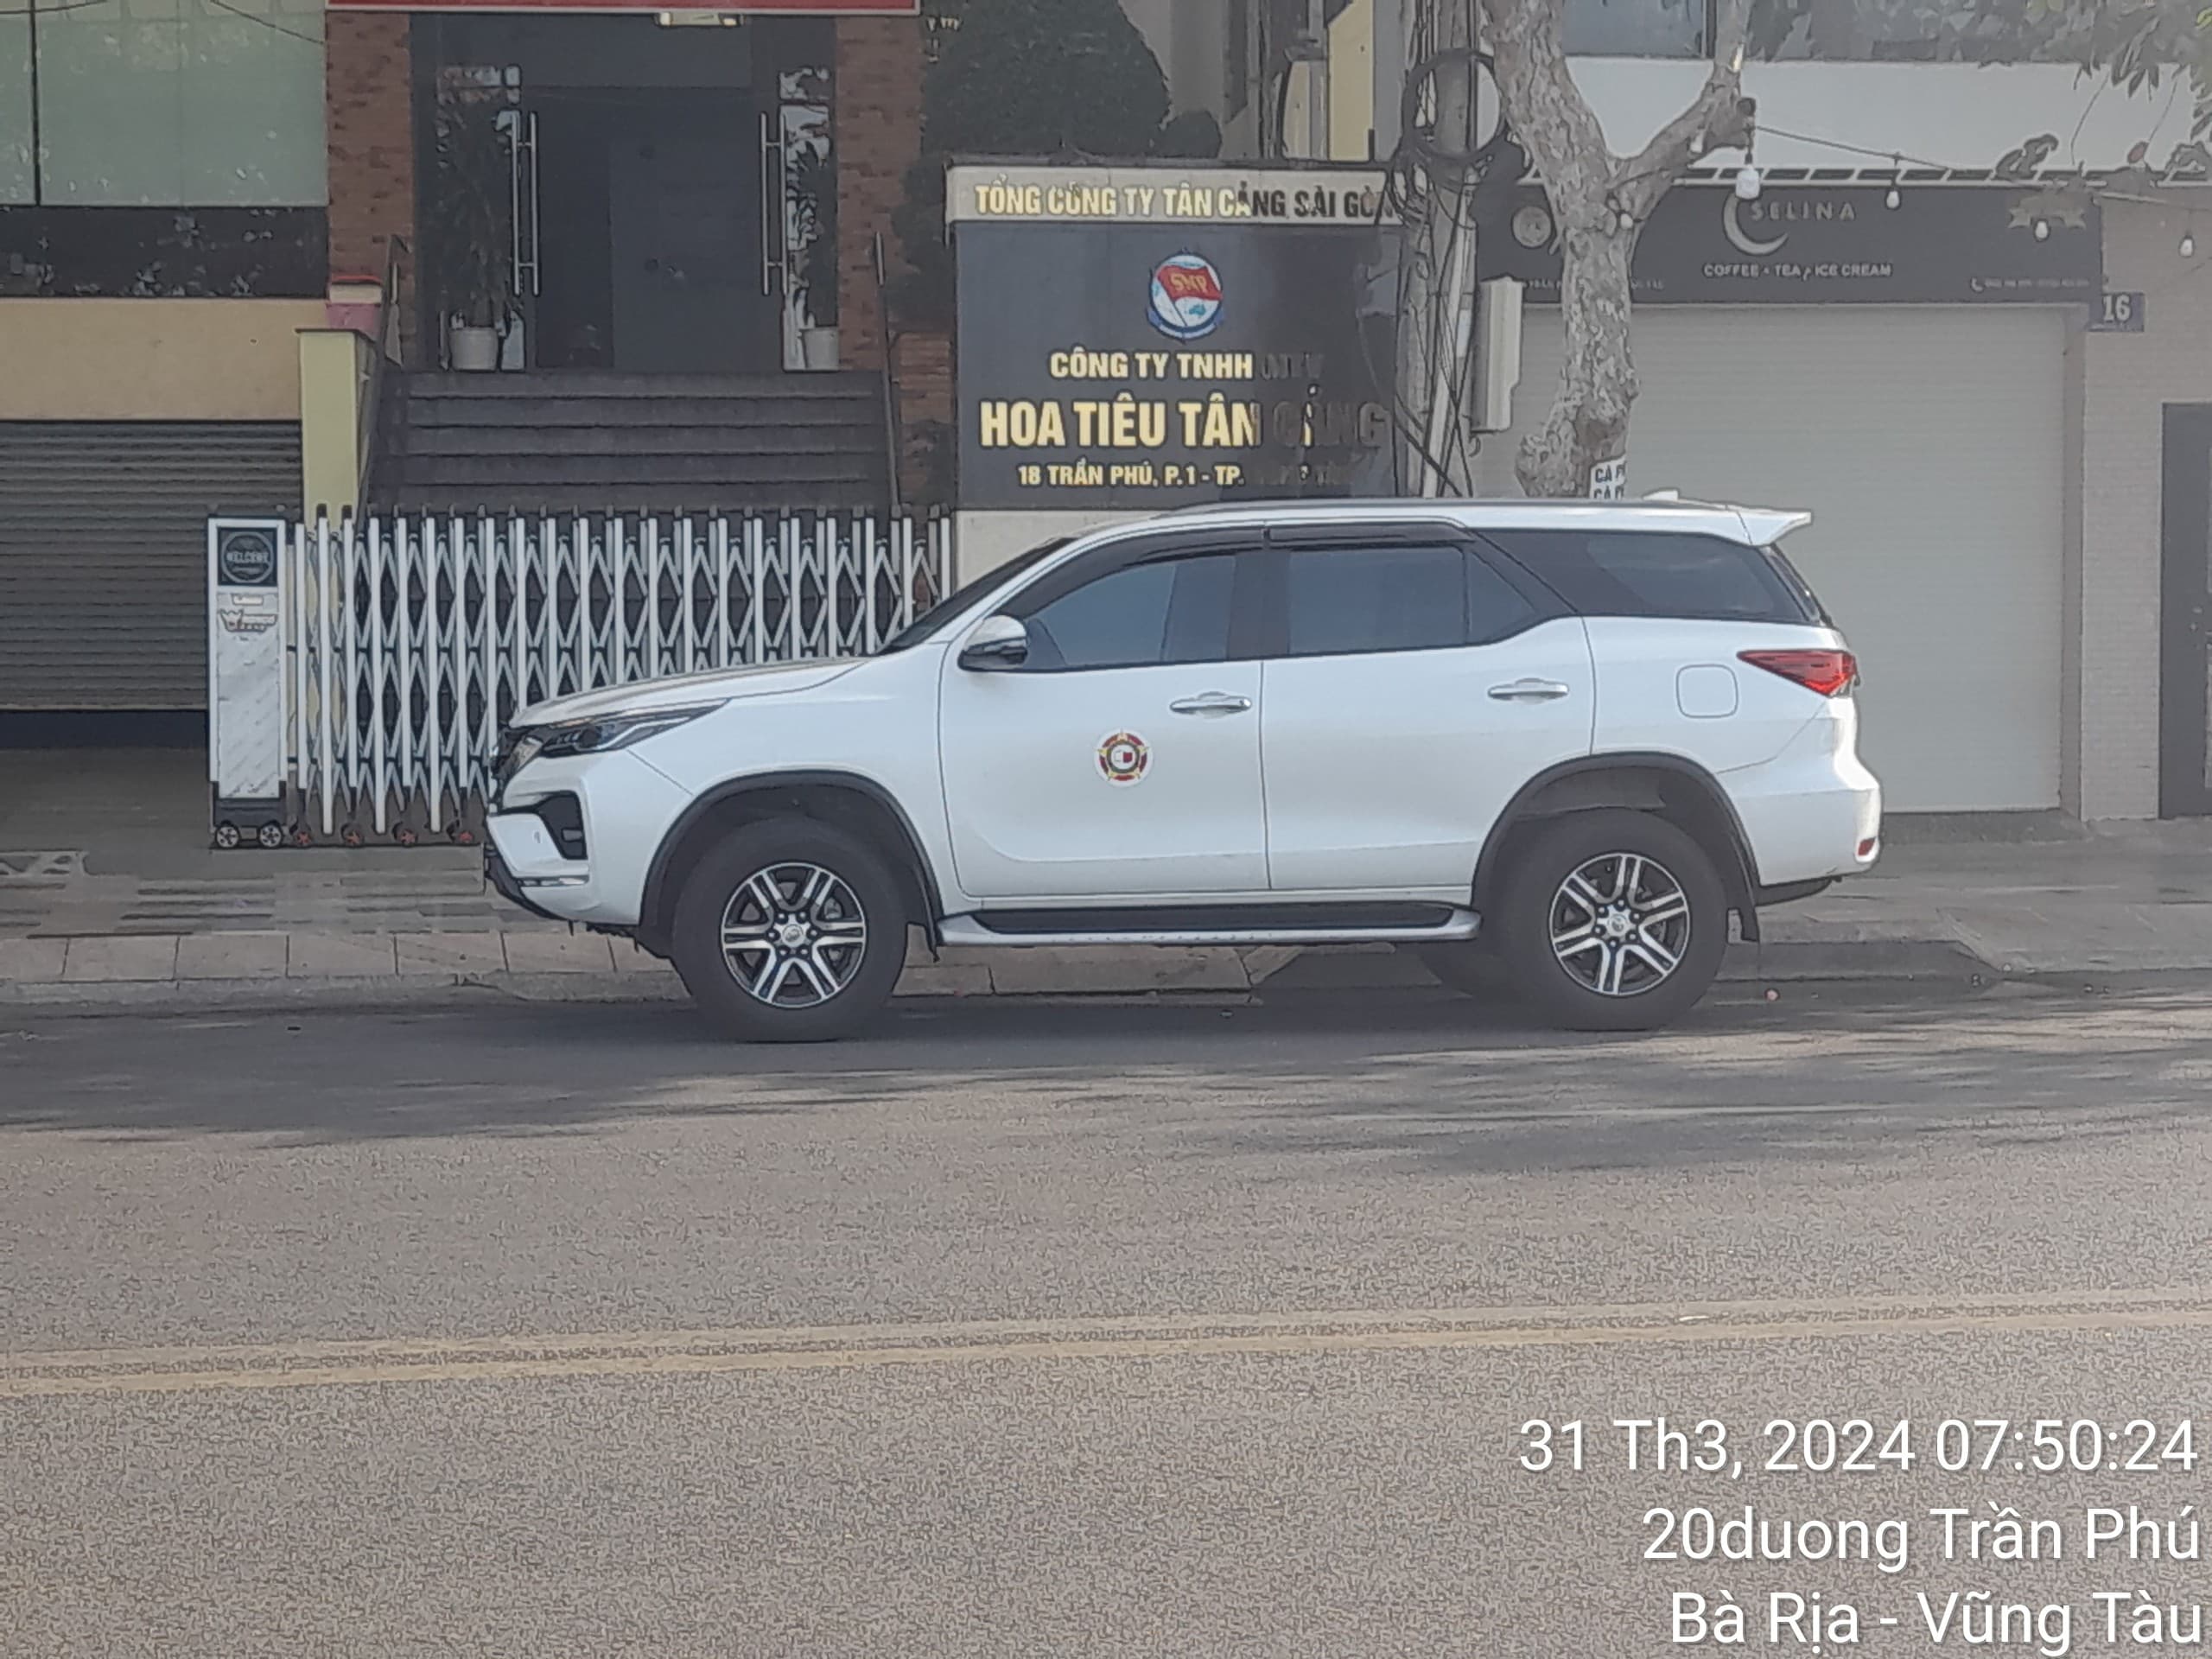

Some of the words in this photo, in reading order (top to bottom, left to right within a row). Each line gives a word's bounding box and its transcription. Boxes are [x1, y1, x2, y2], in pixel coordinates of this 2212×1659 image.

[975, 173, 1041, 214] TỔNG
[1124, 187, 1154, 215] TY
[1163, 182, 1212, 216] TÂN
[1217, 181, 1287, 218] CẢNG
[1294, 185, 1337, 218] SÀI
[1751, 202, 1856, 219] SELINA
[1704, 264, 1760, 277] COFFEE
[1775, 264, 1801, 277] TEA
[1815, 264, 1838, 277] ICE
[1841, 264, 1891, 277] CREAM
[2102, 295, 2131, 321] 16
[1051, 346, 1128, 378] CÔNG
[1135, 353, 1169, 378] TY
[1177, 353, 1253, 378] TNHH
[980, 402, 1065, 446] HOA
[1074, 392, 1166, 446] TIÊU
[1179, 392, 1262, 446] TÂN
[1019, 466, 1040, 485] 18
[1110, 461, 1158, 487] PHÚ,
[1215, 466, 1244, 485] TP.
